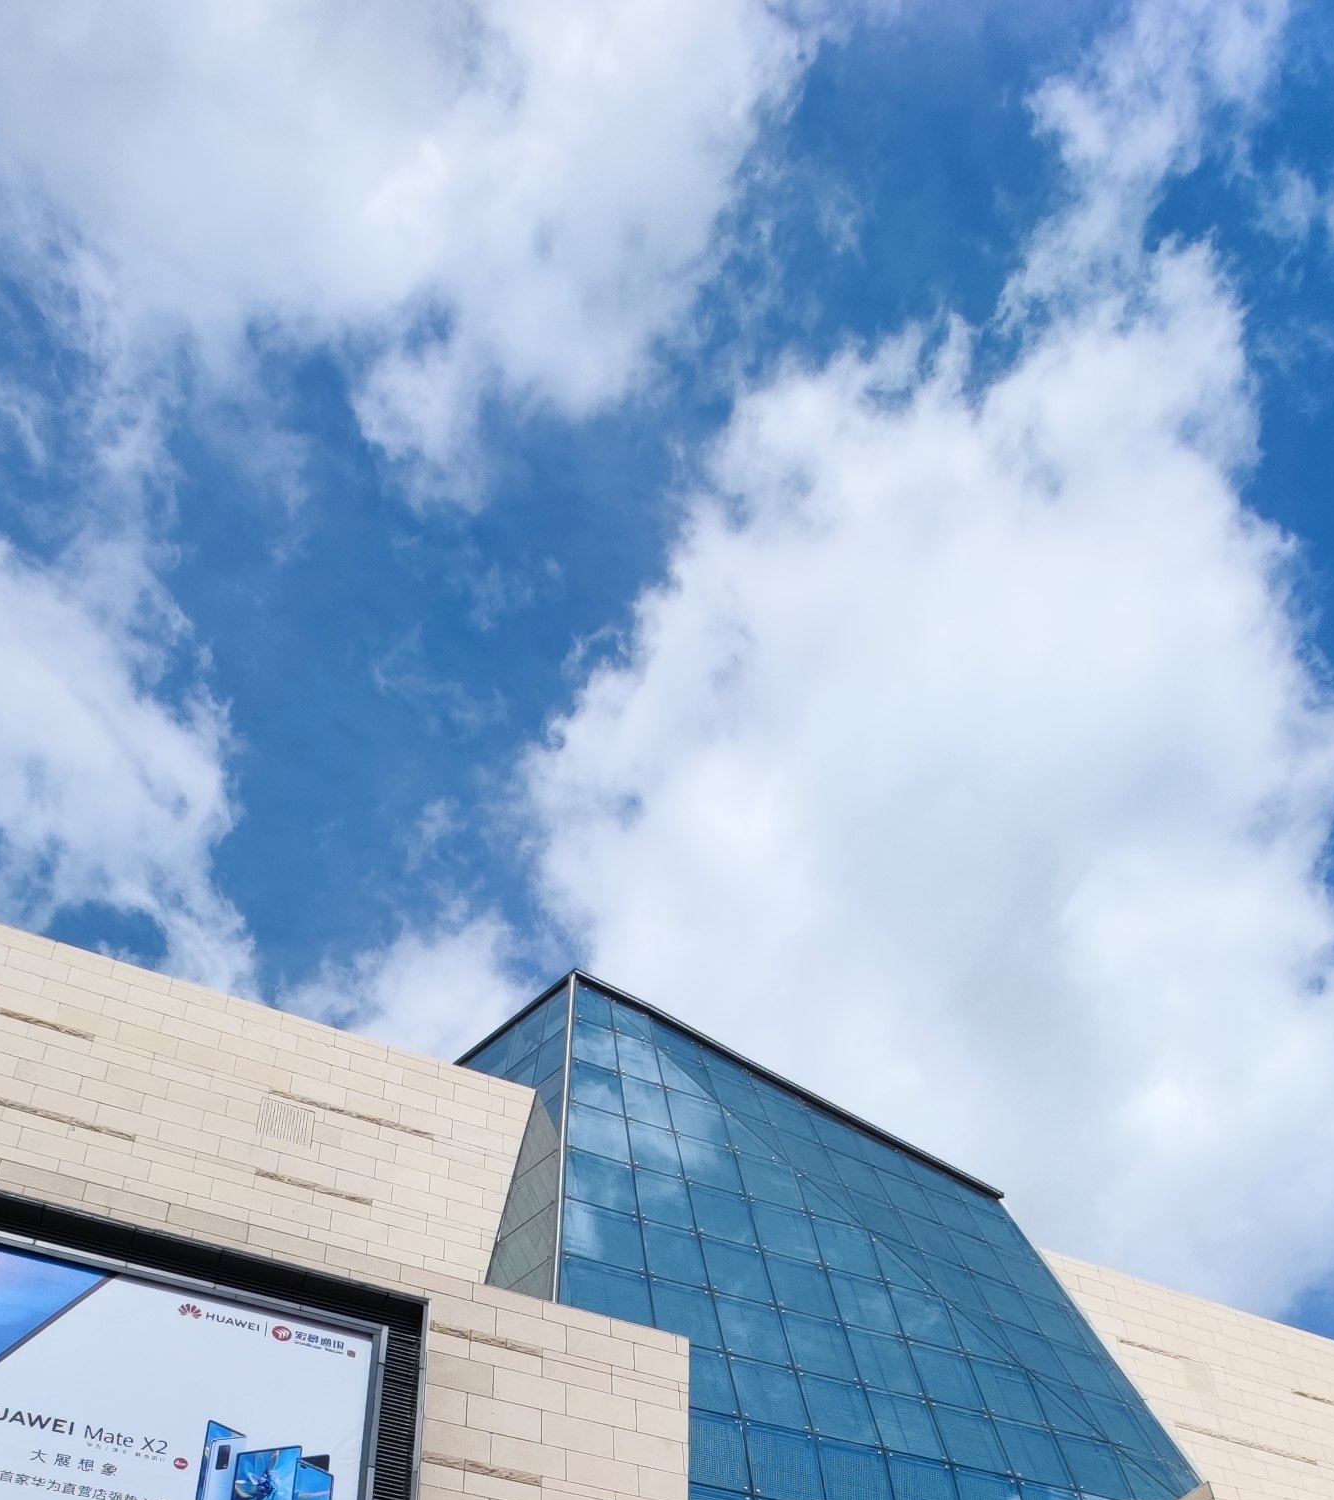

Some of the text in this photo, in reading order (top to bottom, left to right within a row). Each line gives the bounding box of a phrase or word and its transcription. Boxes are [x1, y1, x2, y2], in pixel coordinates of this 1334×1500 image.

[205, 1312, 260, 1331] HUAWEI
[84, 1424, 134, 1448] Mate
[141, 1436, 168, 1454] X2
[30, 1449, 117, 1477] 大展想象
